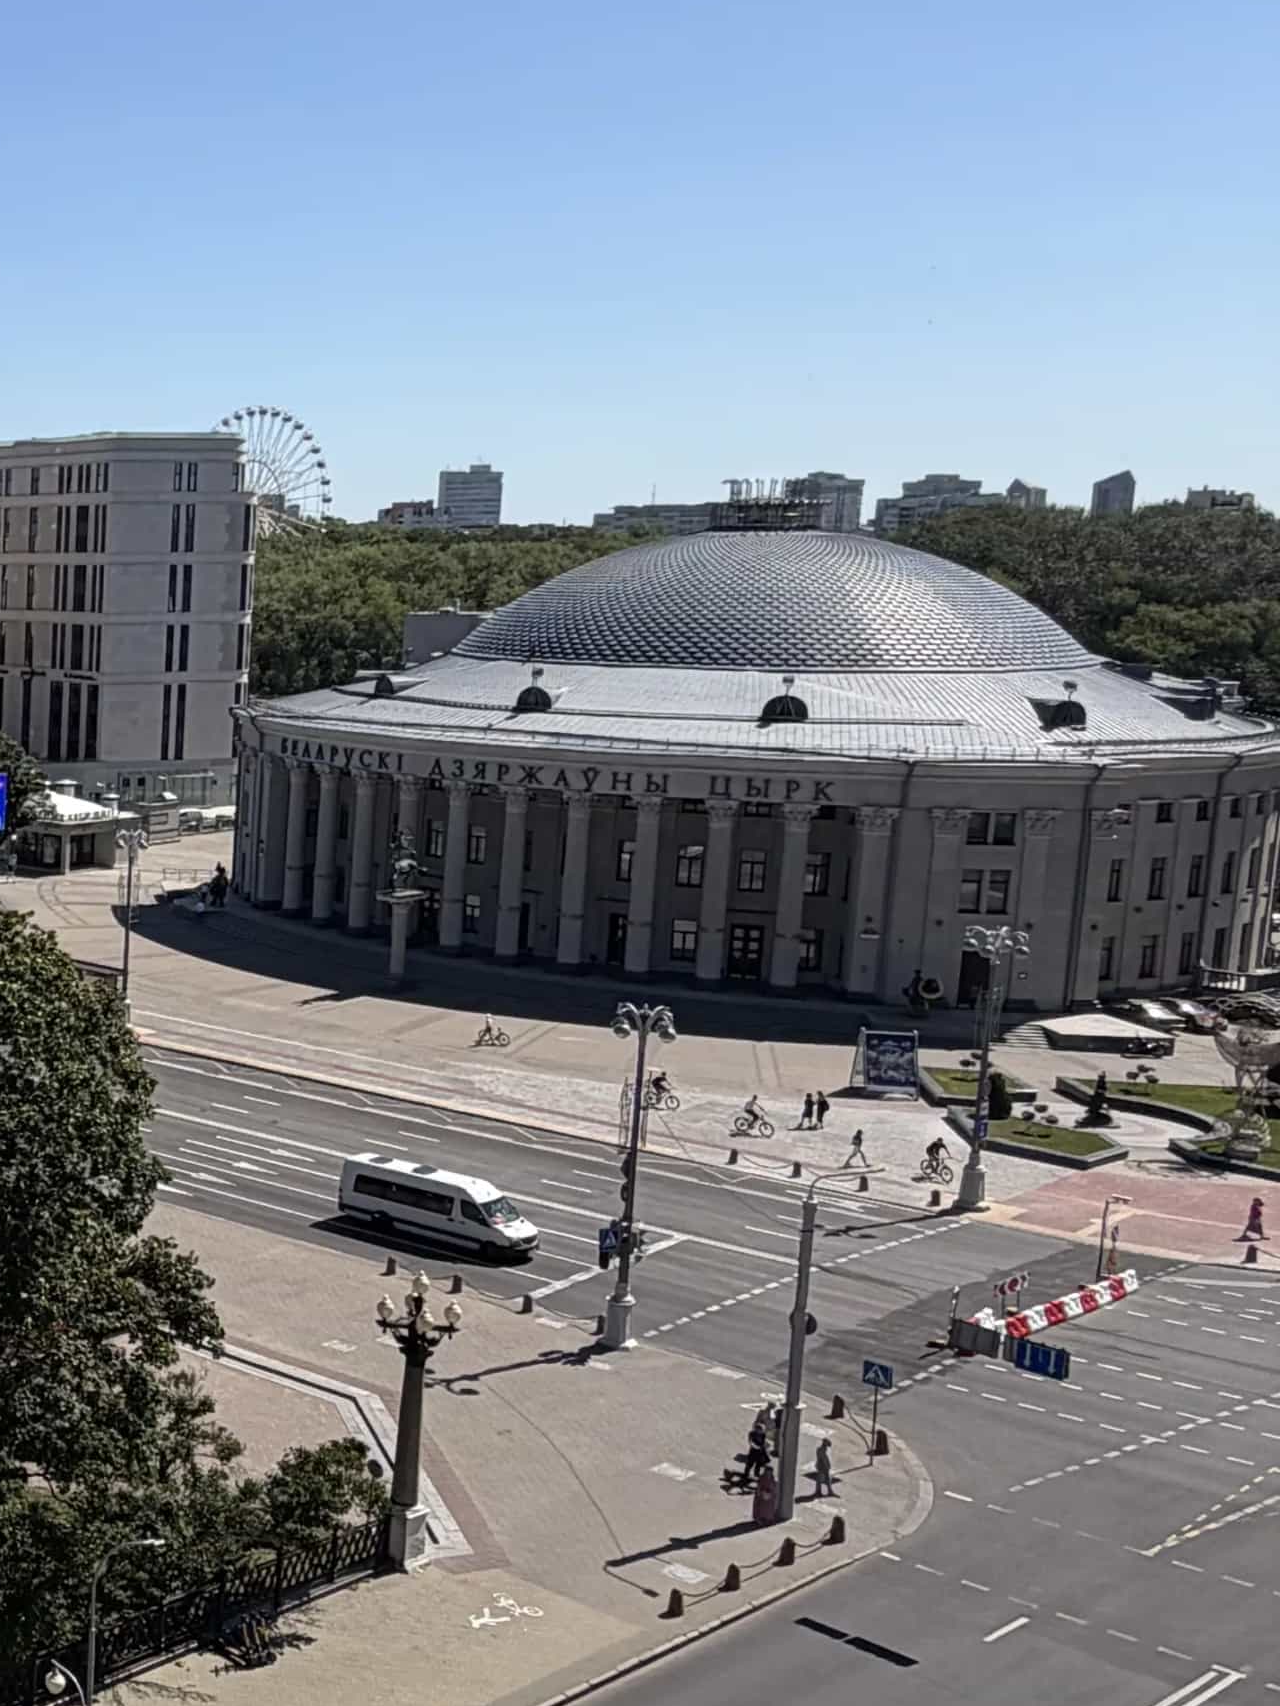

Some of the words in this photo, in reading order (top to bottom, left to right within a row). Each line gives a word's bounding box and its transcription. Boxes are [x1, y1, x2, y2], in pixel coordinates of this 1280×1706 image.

[280, 737, 403, 772] БЕЛАРУСКІ
[428, 759, 670, 794] ДЗЯРЖАЎНЫ
[709, 774, 835, 801] ЦЫРК
